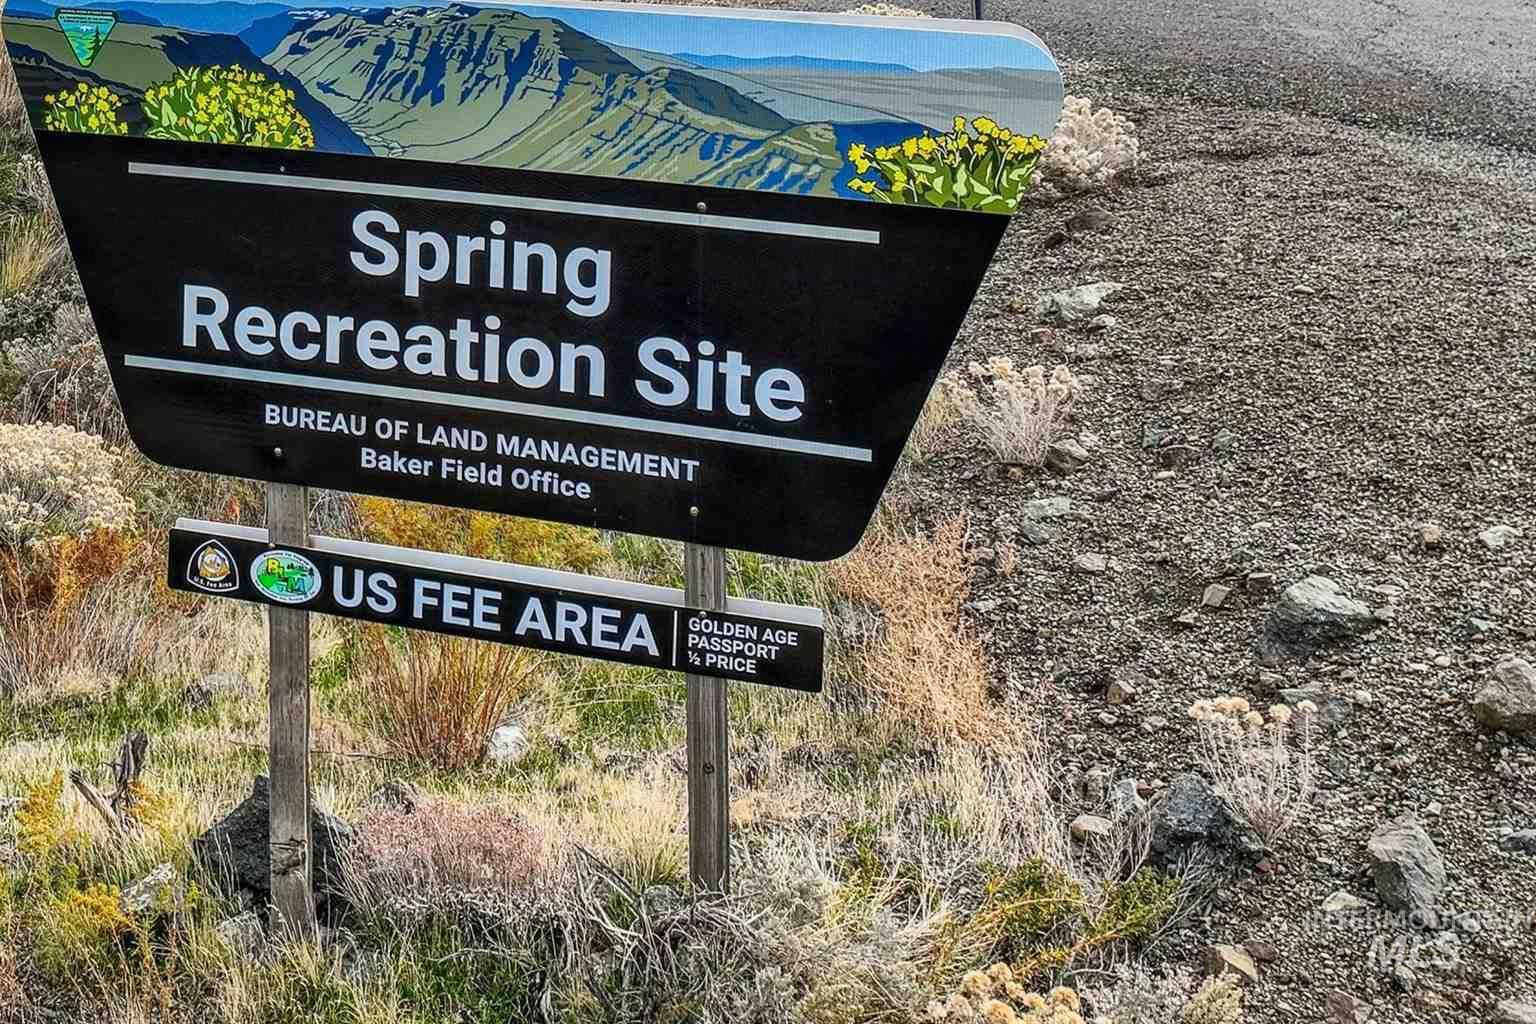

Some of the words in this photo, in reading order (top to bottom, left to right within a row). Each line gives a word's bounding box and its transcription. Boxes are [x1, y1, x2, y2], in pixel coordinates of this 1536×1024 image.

[349, 209, 612, 317] Spring
[182, 283, 606, 398] Recreation
[634, 336, 806, 422] Site
[264, 403, 367, 436] BUREAU
[375, 417, 409, 441] OF
[416, 424, 488, 452] LAND
[496, 433, 700, 481] MANAGEMENT
[360, 447, 433, 477] Baker
[441, 457, 503, 488] Field
[511, 467, 592, 500] Office
[332, 565, 398, 614] US
[413, 578, 503, 632] FEE
[514, 597, 660, 657] AREA
[688, 617, 757, 640] GOLDEN
[762, 628, 799, 646] AGE
[688, 634, 779, 660] PASSPORT
[705, 653, 757, 674] PRICE
